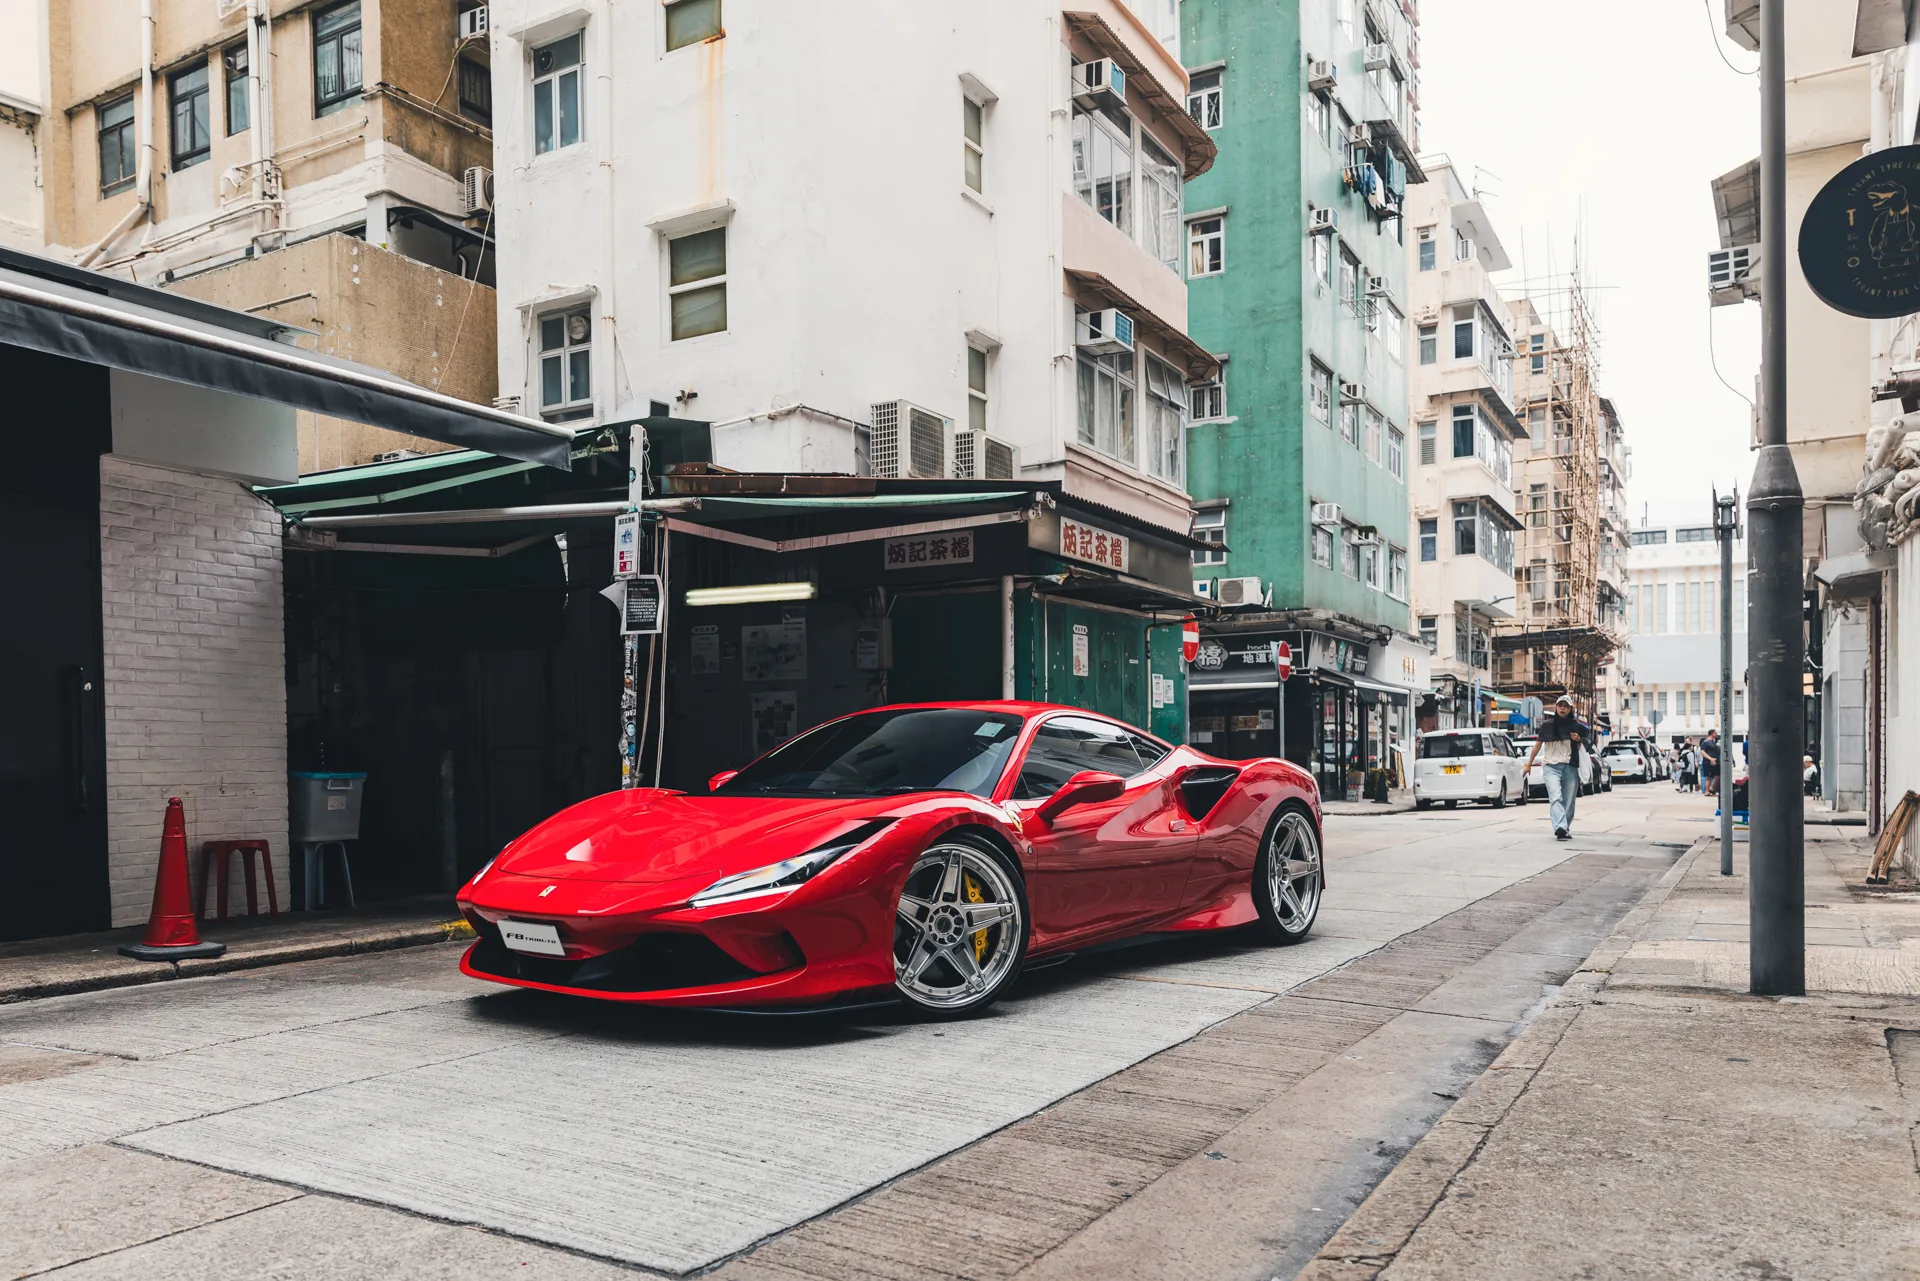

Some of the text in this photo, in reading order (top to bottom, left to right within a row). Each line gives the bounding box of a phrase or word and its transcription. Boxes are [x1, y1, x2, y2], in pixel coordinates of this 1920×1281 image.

[1847, 170, 1876, 196] TYRANT
[1880, 161, 1903, 172] TYRE
[1886, 288, 1910, 298] TYRE
[887, 536, 970, 564] 炳記茶檔
[1063, 521, 1122, 568] 炳記茶檔
[1199, 645, 1221, 666] 橋
[506, 932, 556, 944] F8 TRIBUTO
